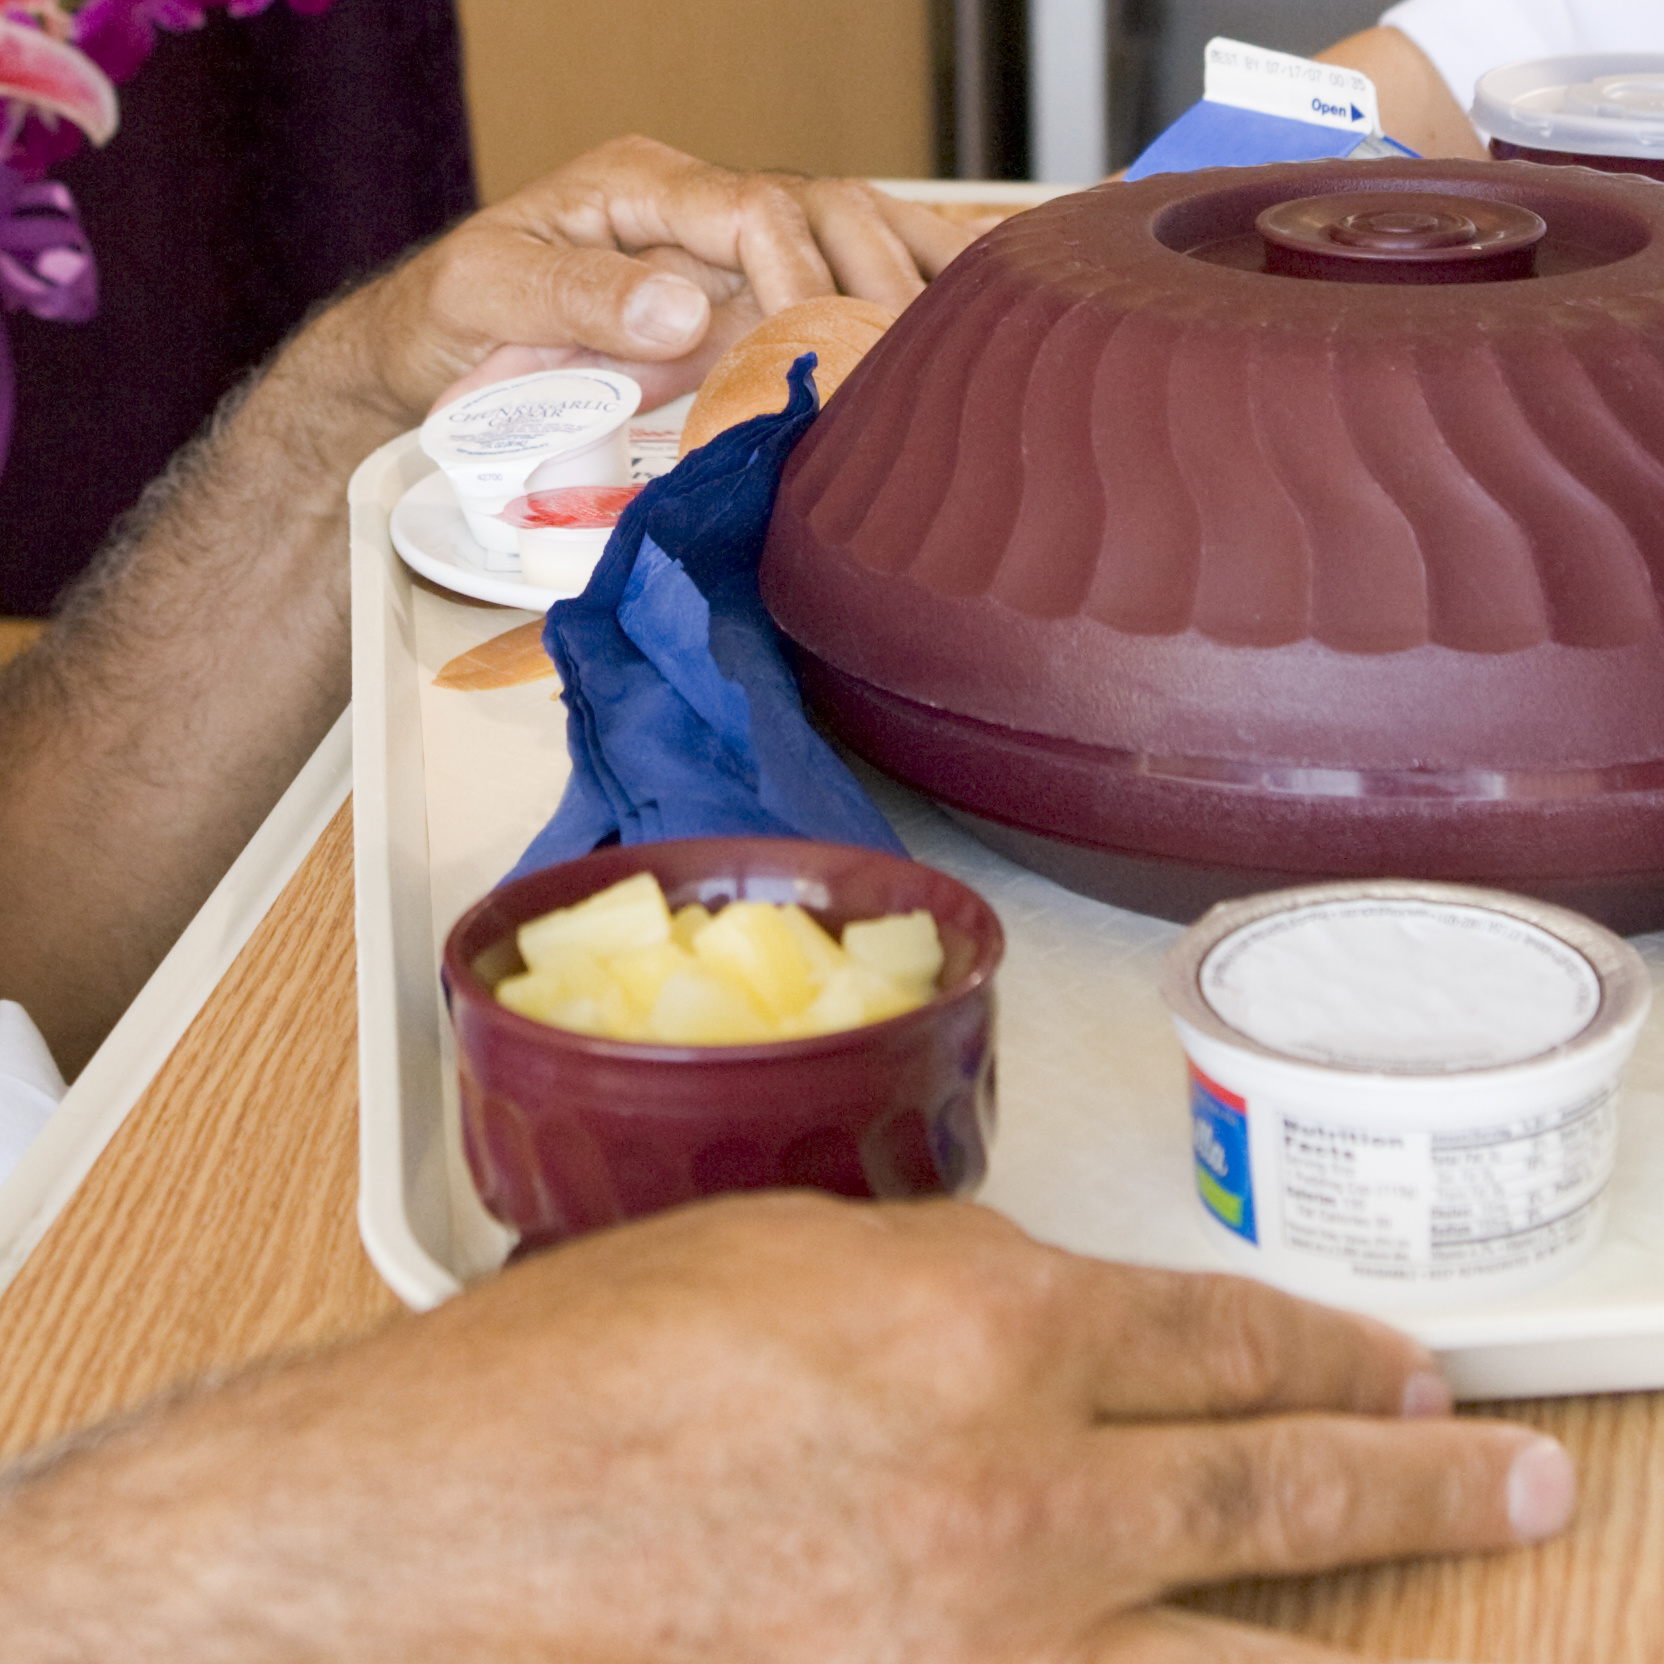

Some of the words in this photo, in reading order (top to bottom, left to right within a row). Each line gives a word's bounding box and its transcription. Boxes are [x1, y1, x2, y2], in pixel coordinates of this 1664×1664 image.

[1210, 49, 1238, 67] BEST
[1245, 56, 1259, 72] BY
[1265, 60, 1322, 83] 07/17/07
[1311, 97, 1347, 117] Open
[1283, 1117, 1405, 1148] Nutrition
[1283, 1135, 1356, 1162] Facts
